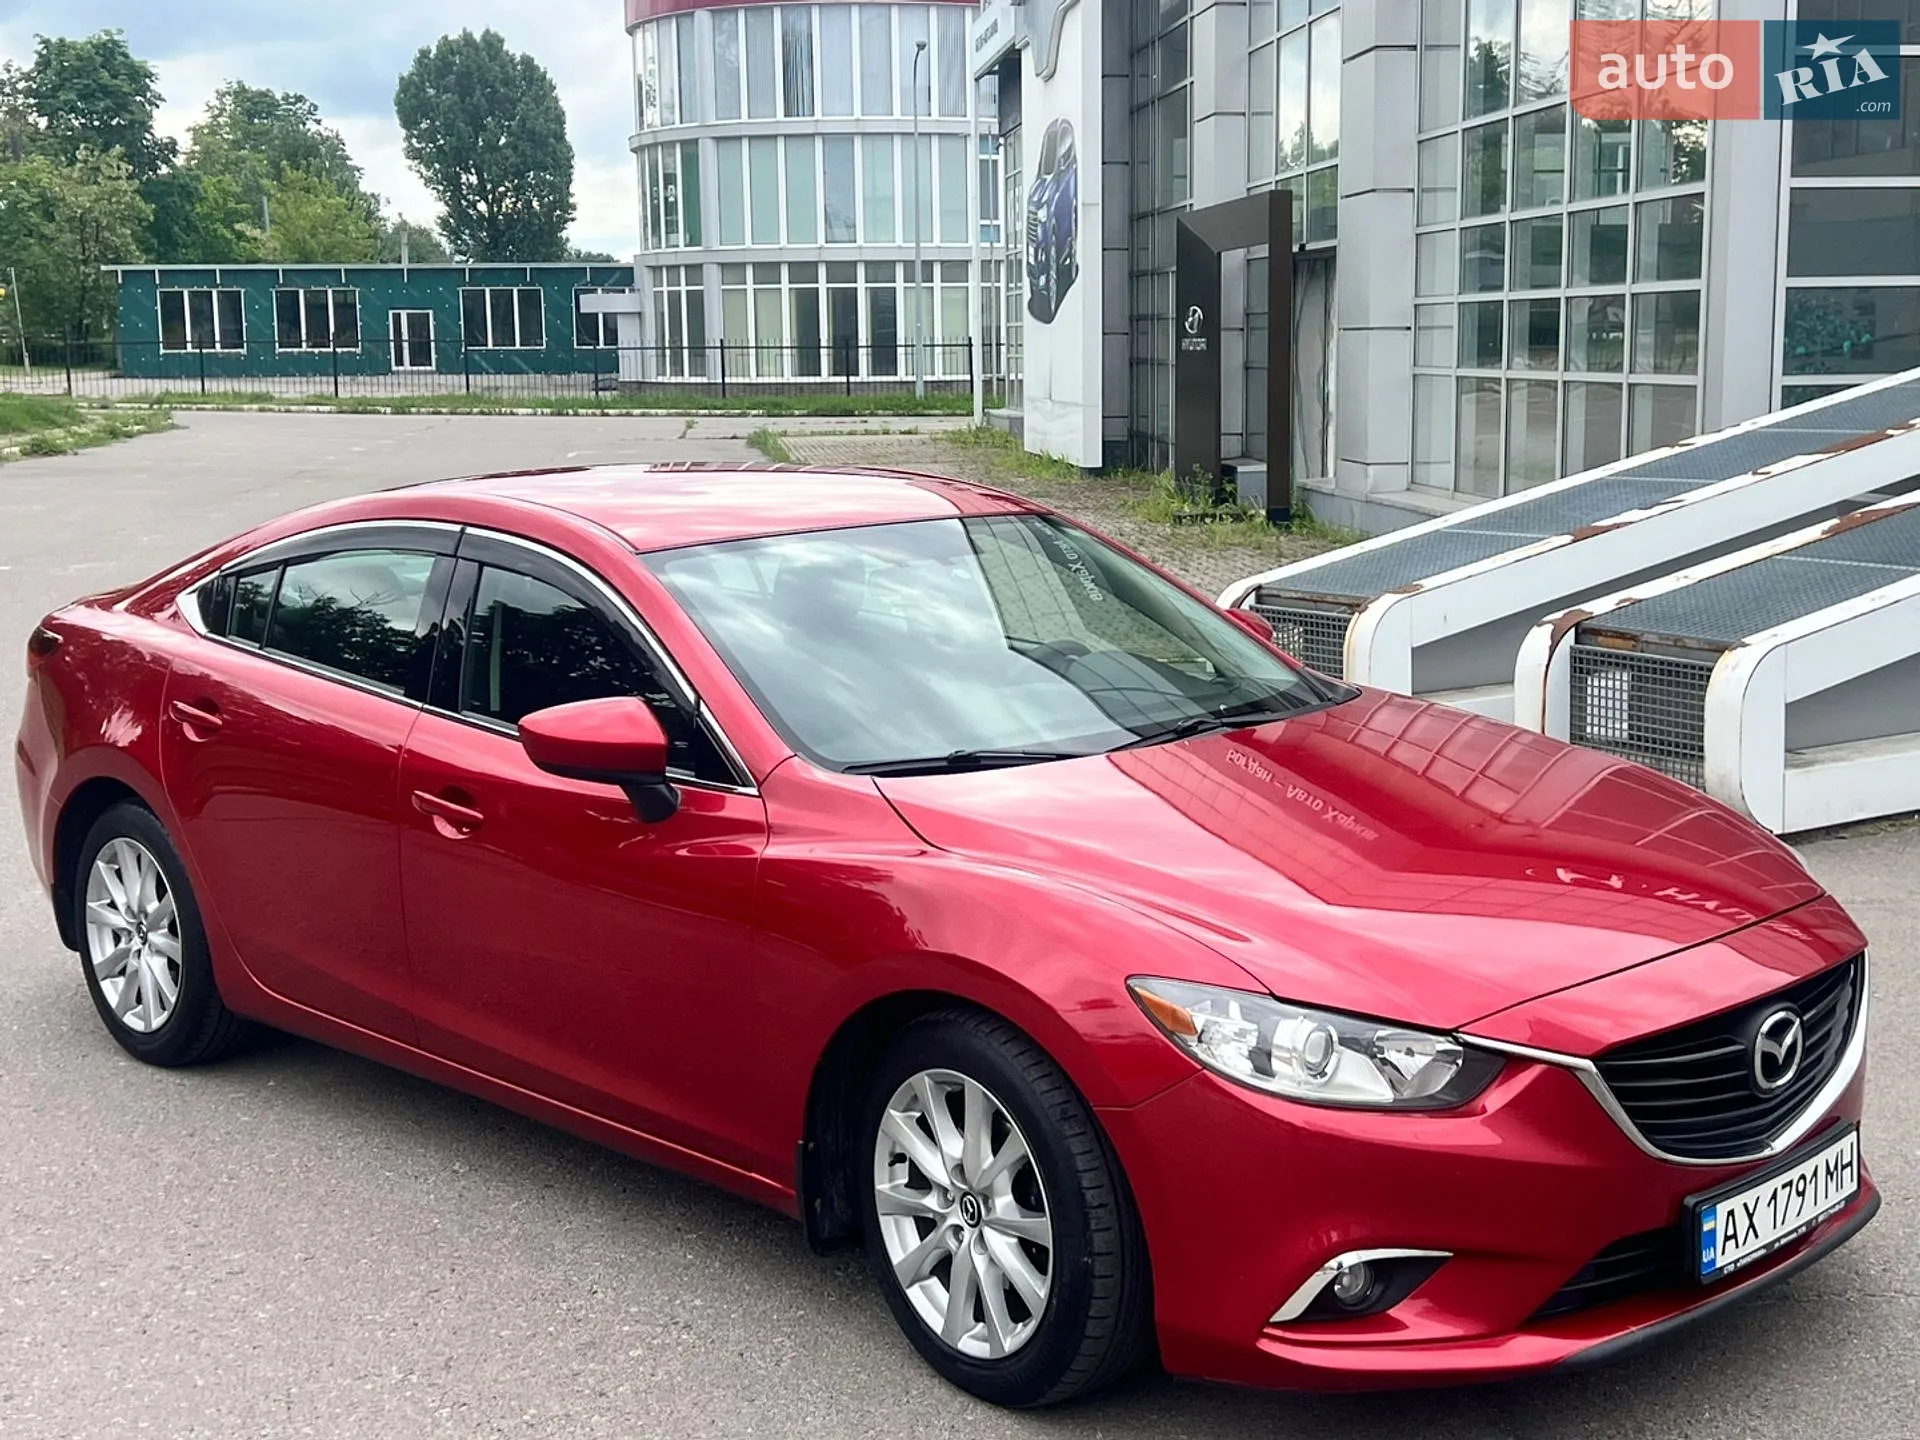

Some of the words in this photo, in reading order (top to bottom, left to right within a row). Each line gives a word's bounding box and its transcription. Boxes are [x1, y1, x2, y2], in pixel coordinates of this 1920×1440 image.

[1721, 1195, 1760, 1256] AX
[1767, 1164, 1820, 1230] 1791
[1825, 1141, 1854, 1200] MH
[1702, 1246, 1716, 1264] UA
